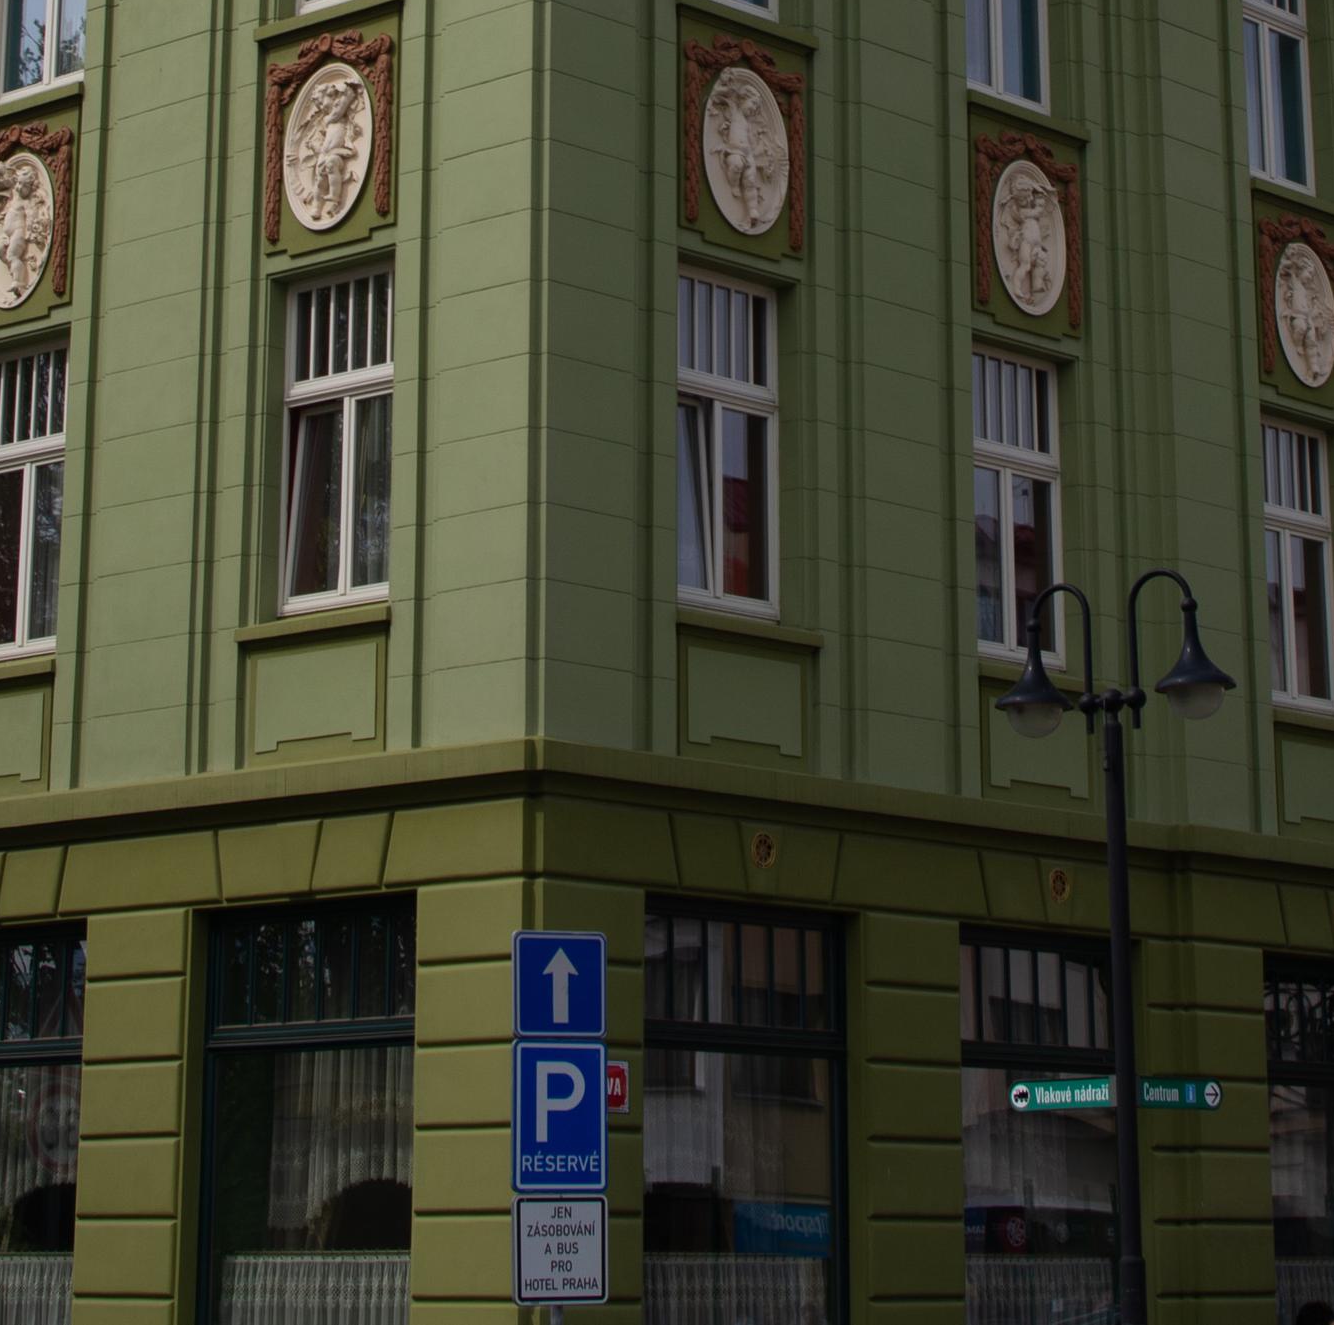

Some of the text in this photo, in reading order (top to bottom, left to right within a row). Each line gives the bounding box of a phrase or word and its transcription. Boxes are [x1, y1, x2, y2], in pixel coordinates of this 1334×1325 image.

[1034, 1079, 1109, 1104] Vlakové nádraží
[1143, 1081, 1179, 1102] Centrum
[536, 1061, 585, 1143] P
[522, 1150, 600, 1173] RÉSERVÉ
[551, 1206, 572, 1219] JEN
[527, 1221, 596, 1237] ZÁSOBOVÁNÍ
[544, 1242, 579, 1255] A BUS
[550, 1260, 573, 1273] PRO
[524, 1277, 599, 1292] HOTEL PRAHA
